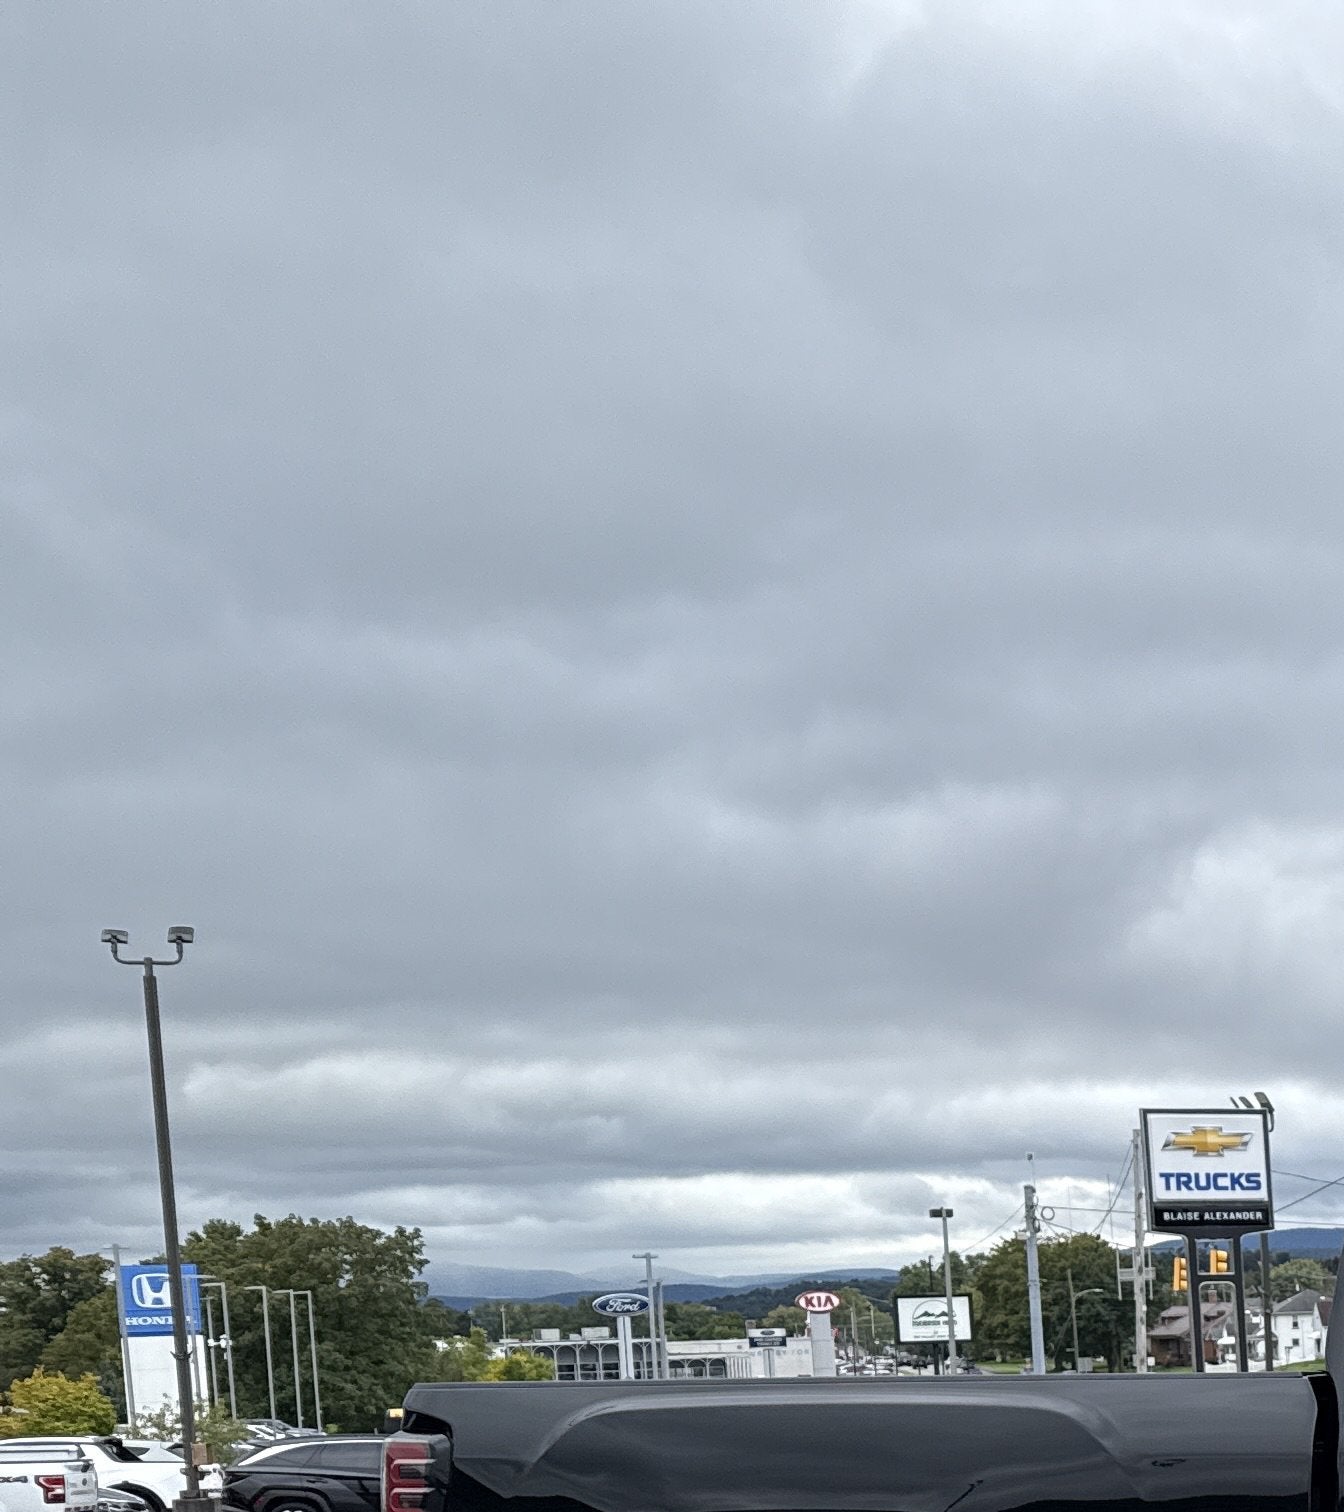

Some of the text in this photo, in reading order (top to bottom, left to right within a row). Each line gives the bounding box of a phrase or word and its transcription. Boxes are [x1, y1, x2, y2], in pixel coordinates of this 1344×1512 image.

[1159, 1172, 1262, 1191] TRUCKS
[1163, 1211, 1264, 1221] BLAISE ALEXANDER
[606, 1298, 641, 1312] Ford
[803, 1295, 835, 1308] KIA
